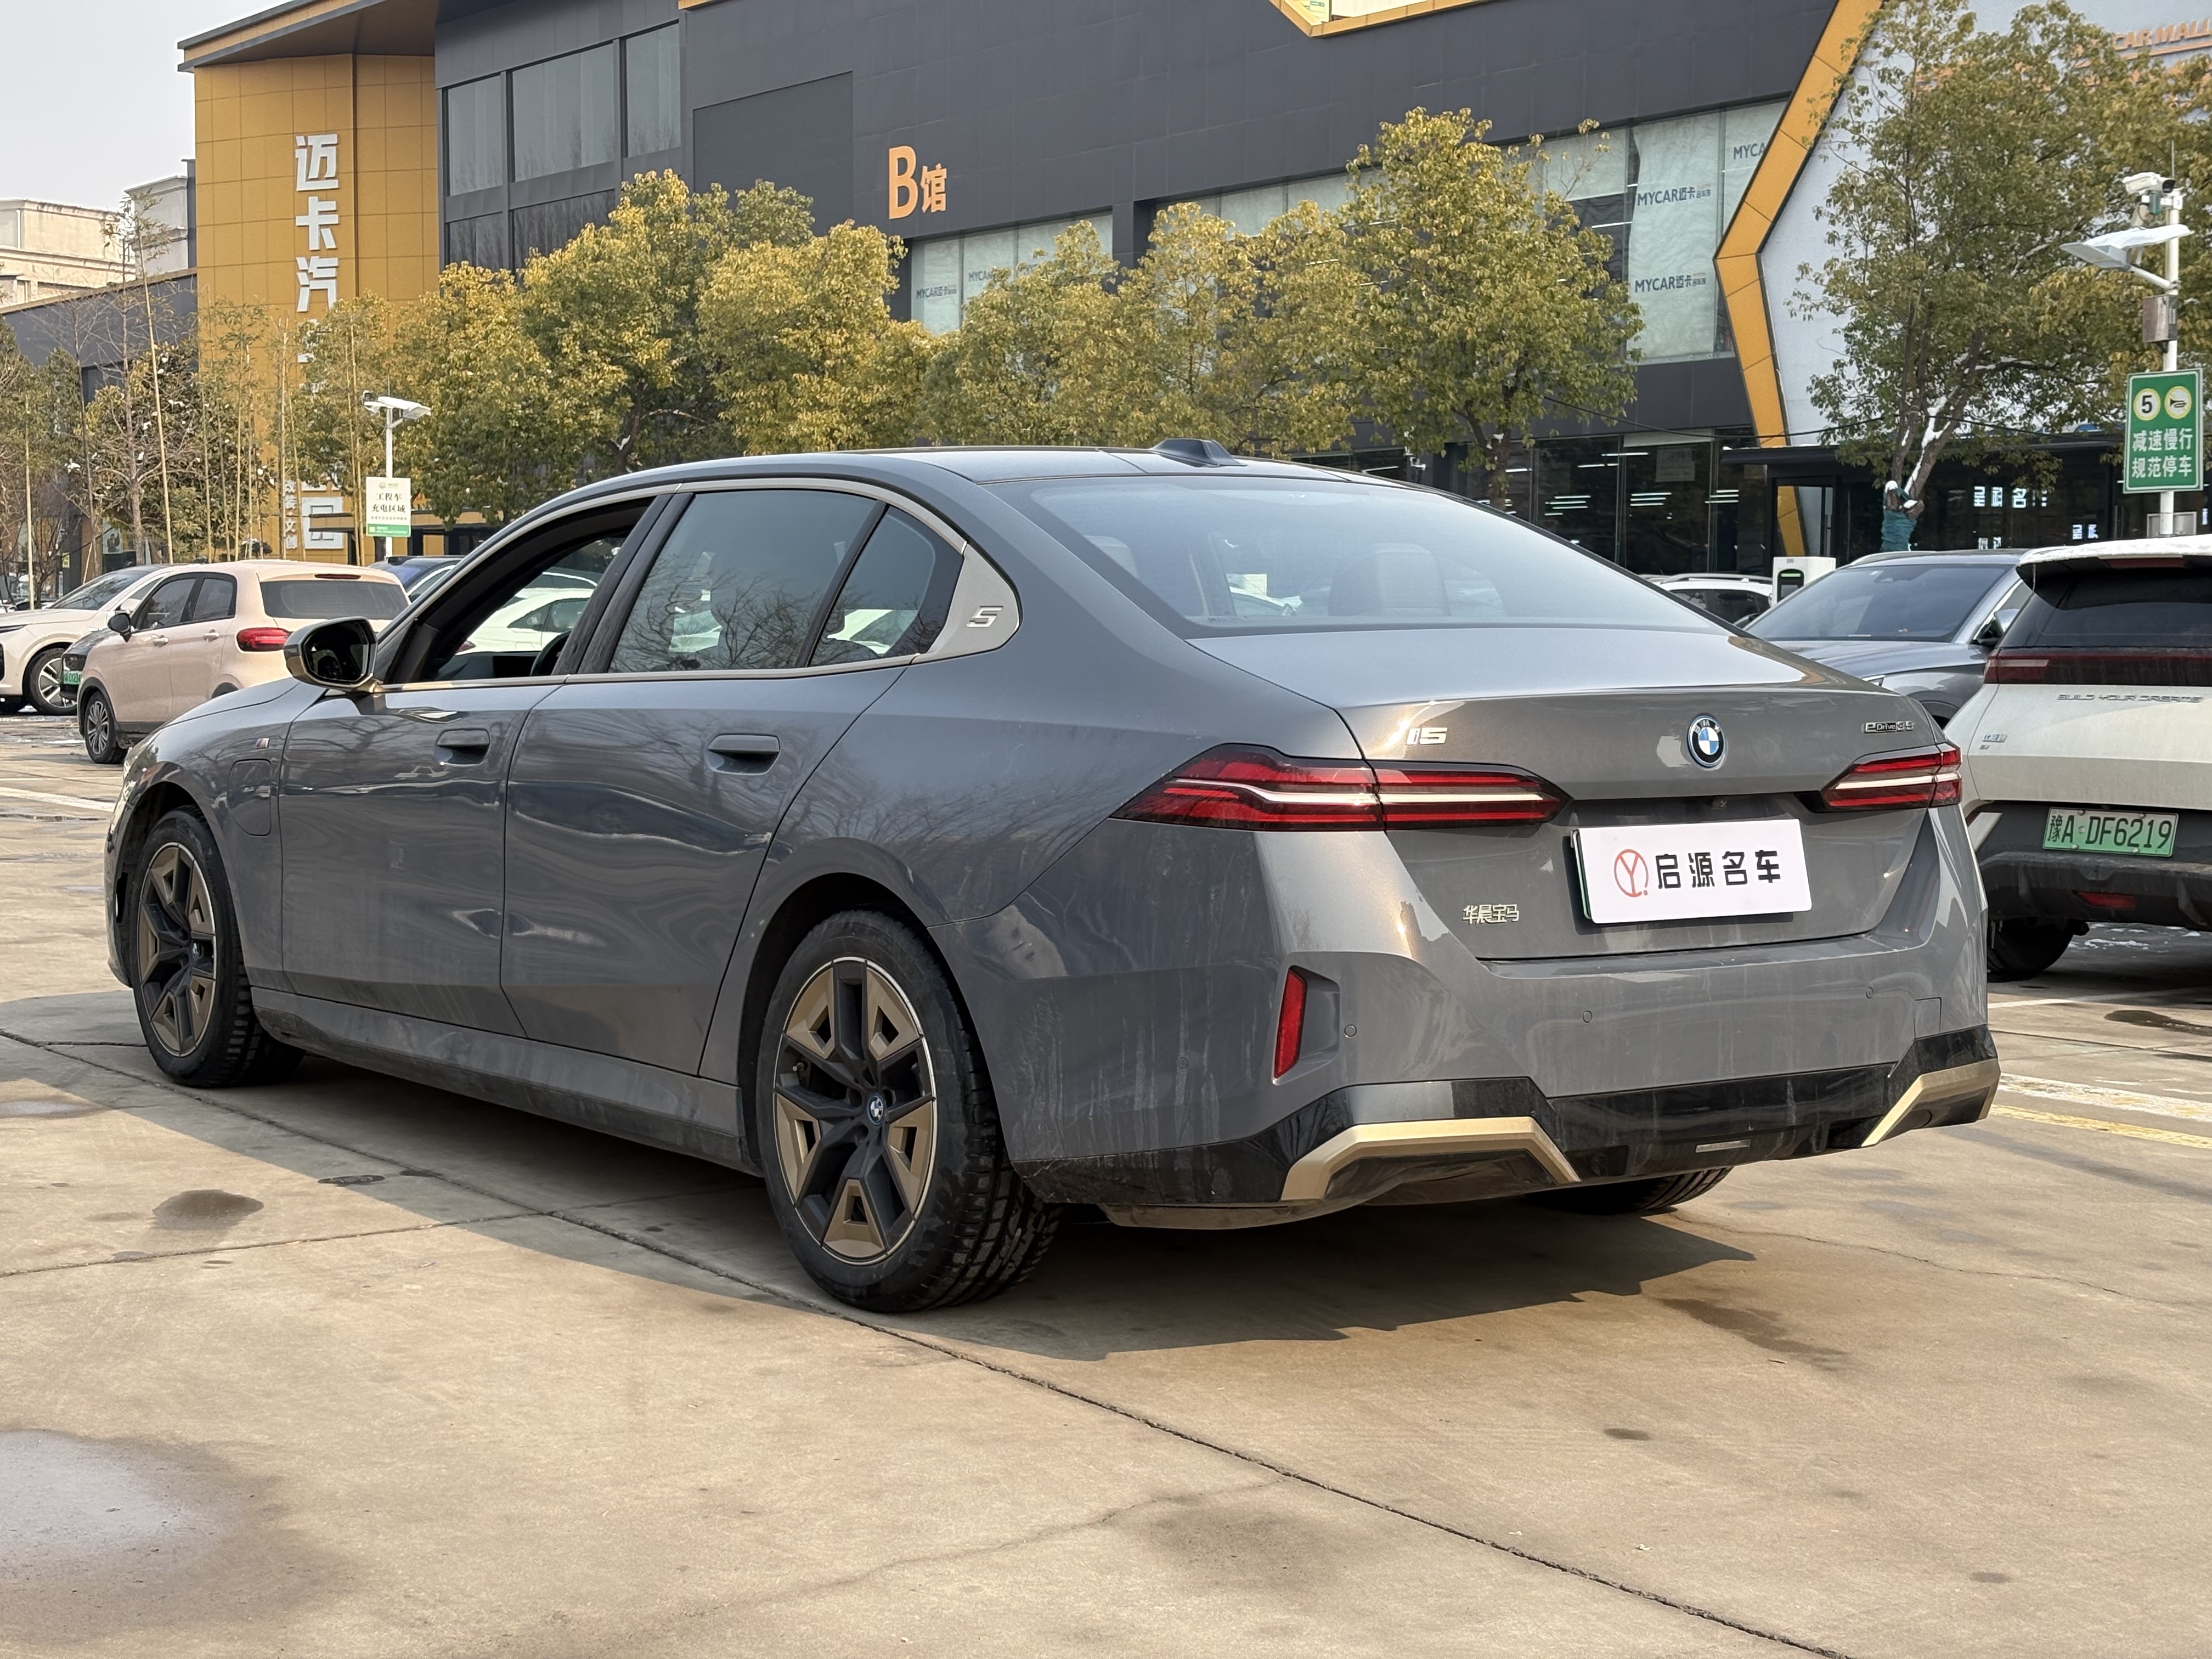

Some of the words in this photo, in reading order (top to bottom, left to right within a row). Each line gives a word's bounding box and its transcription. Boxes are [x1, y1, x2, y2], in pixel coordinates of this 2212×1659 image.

[889, 145, 947, 219] B馆
[2142, 395, 2152, 413] 5
[2132, 428, 2193, 452] 减速慢行
[2131, 455, 2192, 478] 规范停车
[1406, 727, 1448, 745] i5
[1694, 720, 1720, 733] BMW
[1655, 850, 1781, 889] 启源名车
[1462, 904, 1520, 924] 华晨宝马
